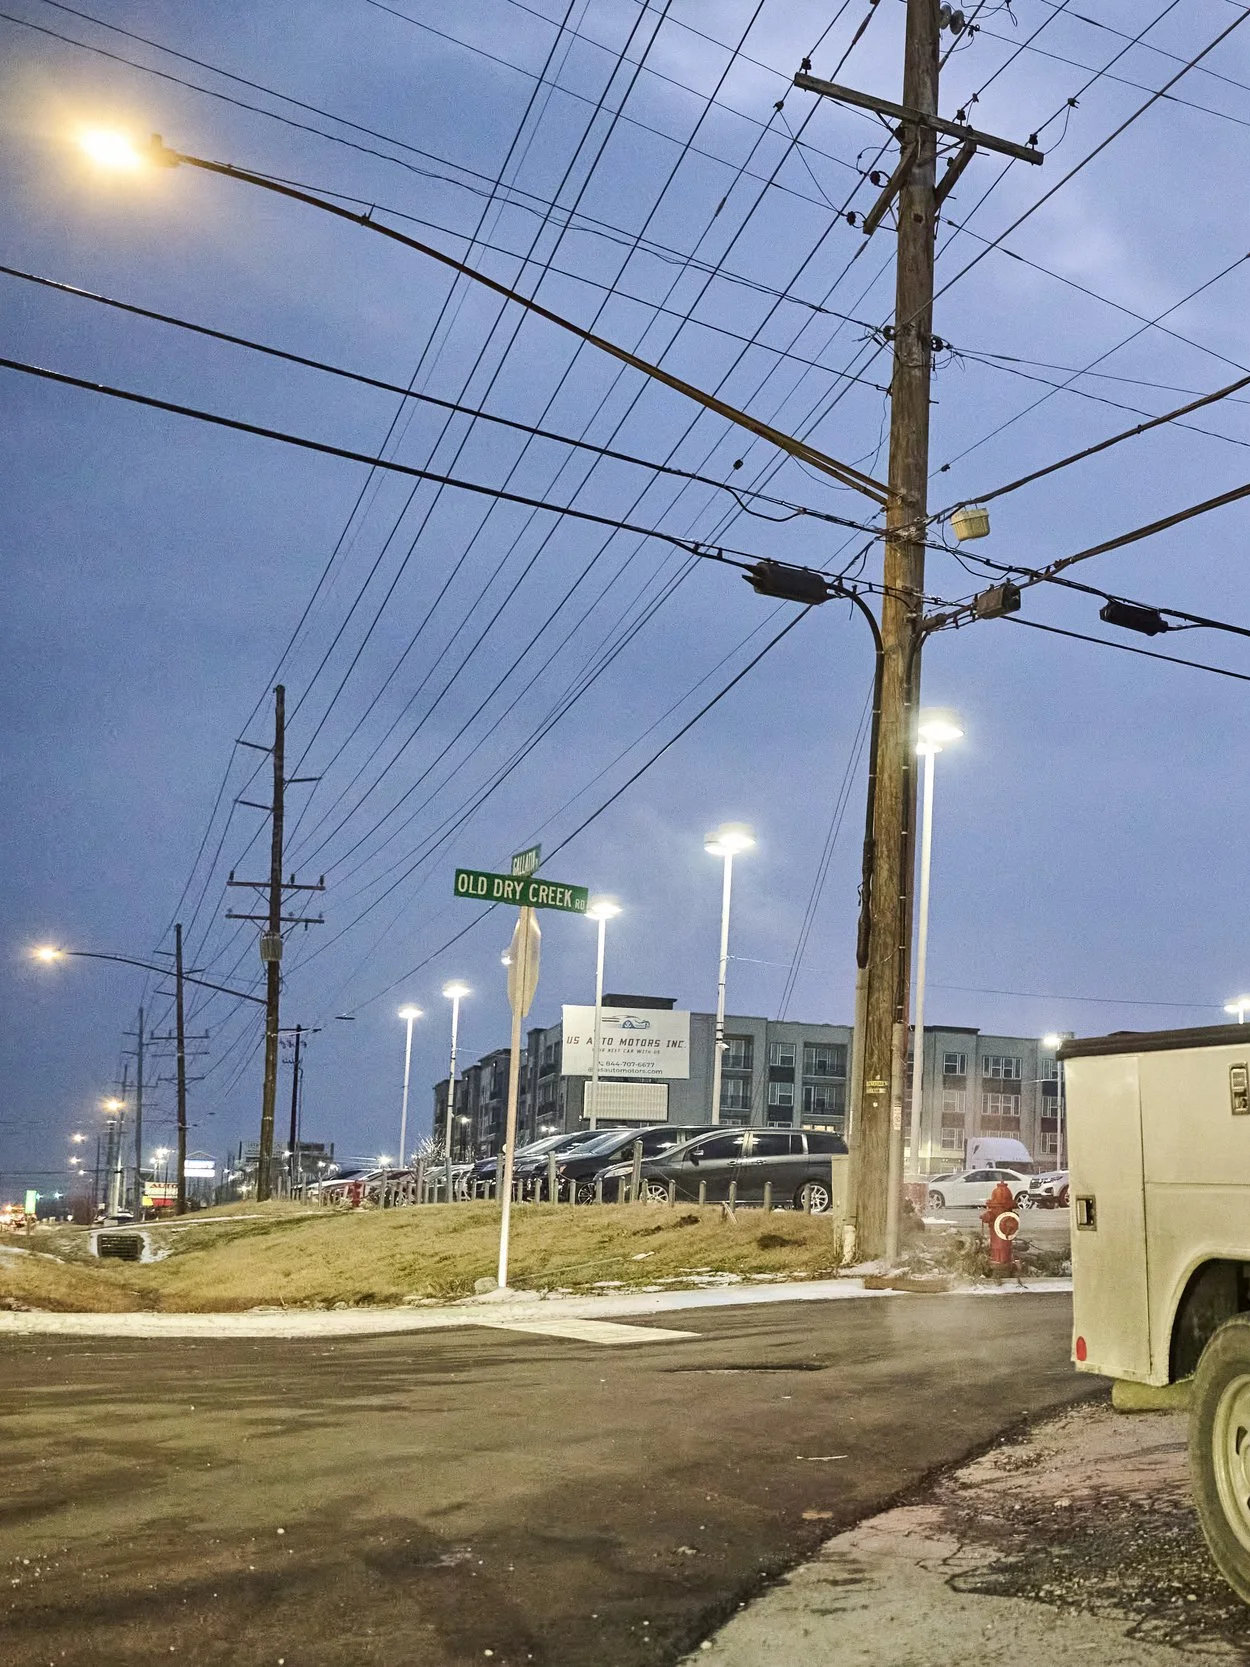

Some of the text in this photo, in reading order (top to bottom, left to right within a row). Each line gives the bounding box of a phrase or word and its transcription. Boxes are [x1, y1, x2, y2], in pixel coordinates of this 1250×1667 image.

[457, 873, 585, 911] OLD DRY CREEK RD
[566, 1036, 688, 1049] US ATO MOTORS INC.
